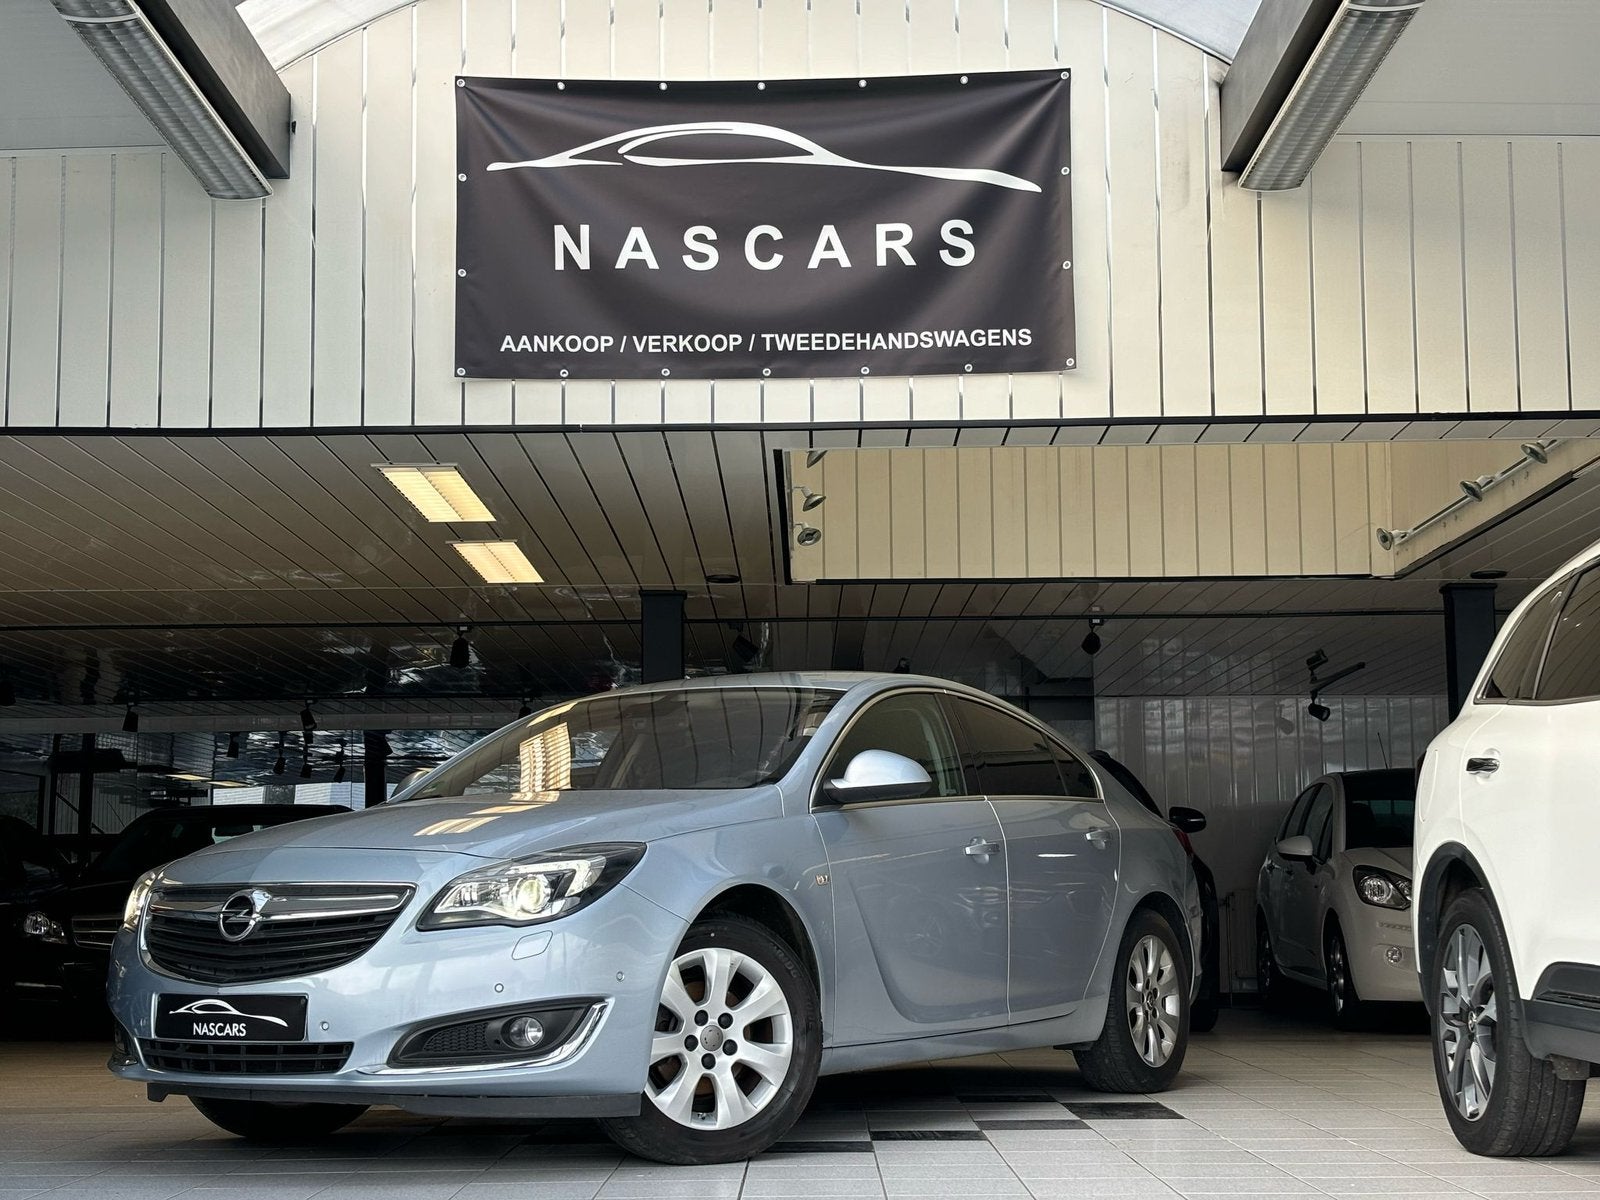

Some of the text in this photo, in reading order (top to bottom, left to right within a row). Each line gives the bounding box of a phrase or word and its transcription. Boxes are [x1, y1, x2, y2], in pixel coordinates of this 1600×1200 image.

[553, 219, 976, 271] NASCARS
[499, 328, 1033, 353] AANKOOP / VERKOOP / TWEEDEHANDSWAGENS
[193, 1022, 247, 1037] NASCARS
